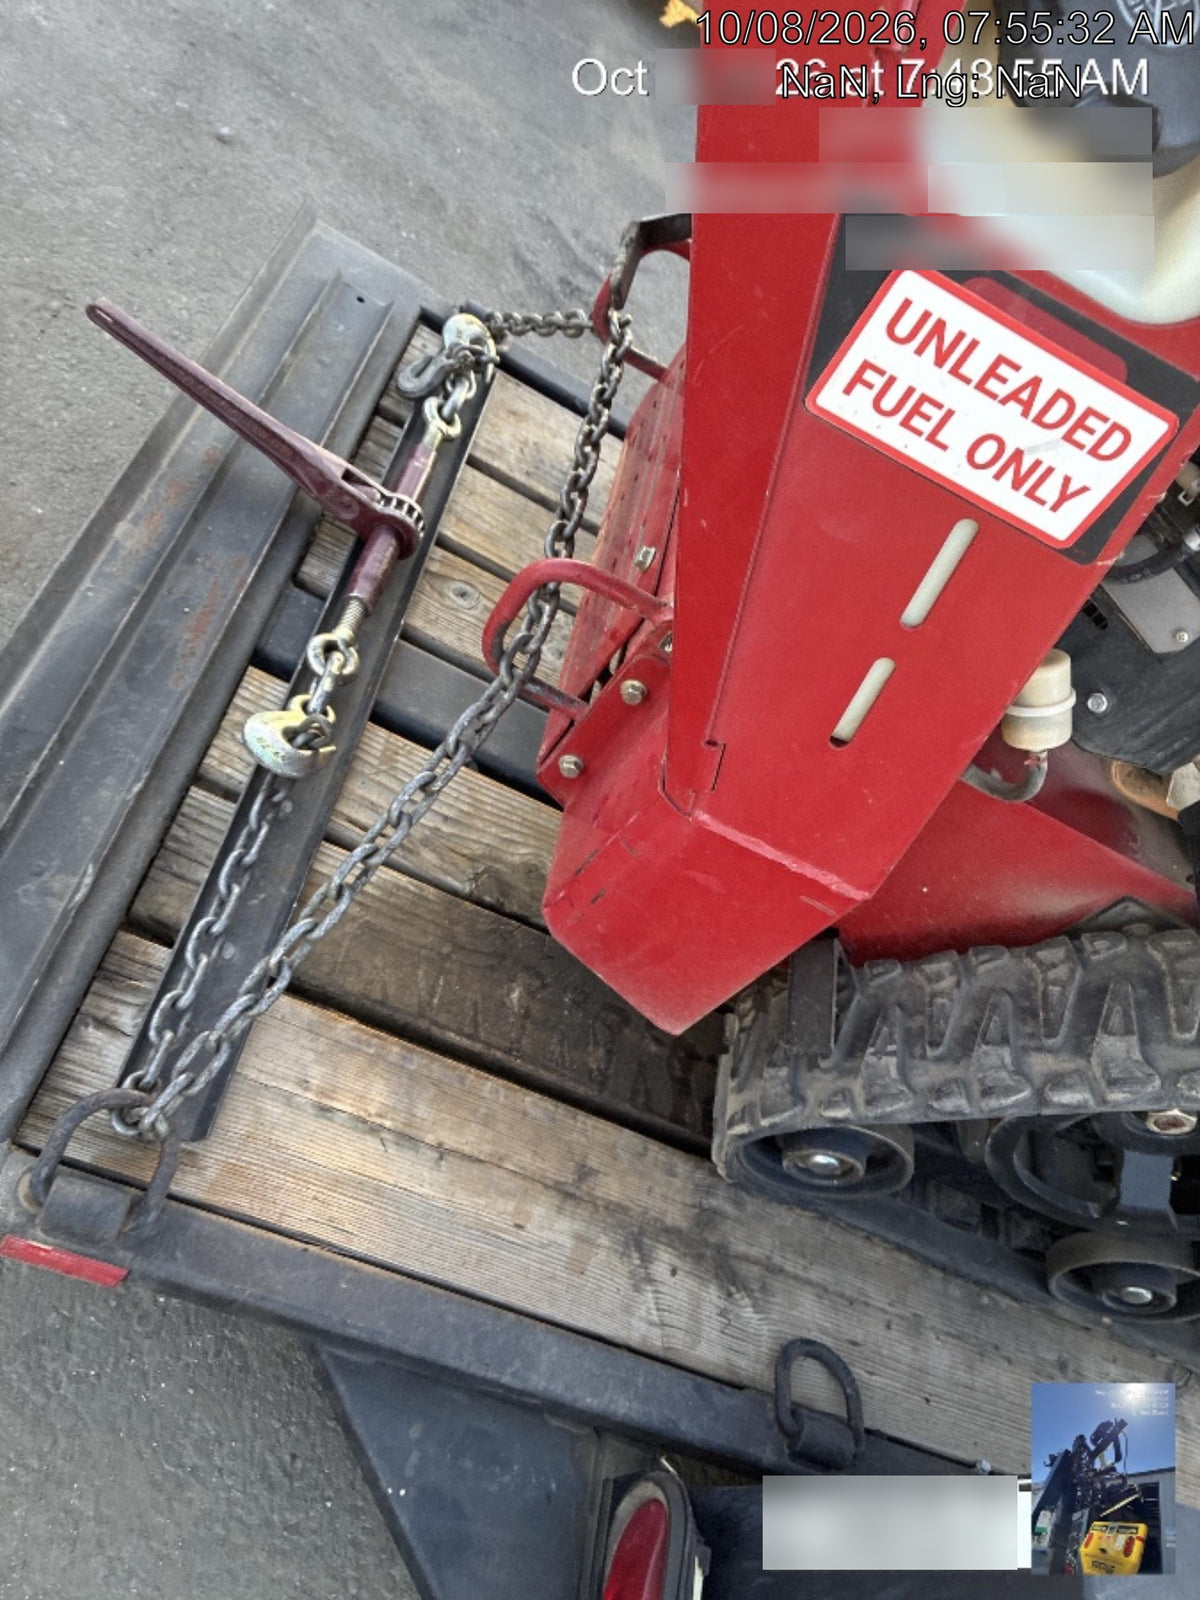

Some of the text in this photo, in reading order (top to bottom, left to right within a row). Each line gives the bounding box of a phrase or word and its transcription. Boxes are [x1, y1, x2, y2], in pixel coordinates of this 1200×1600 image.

[842, 359, 1092, 513] FUEL ONLY
[886, 298, 1132, 462] UNLEADED
